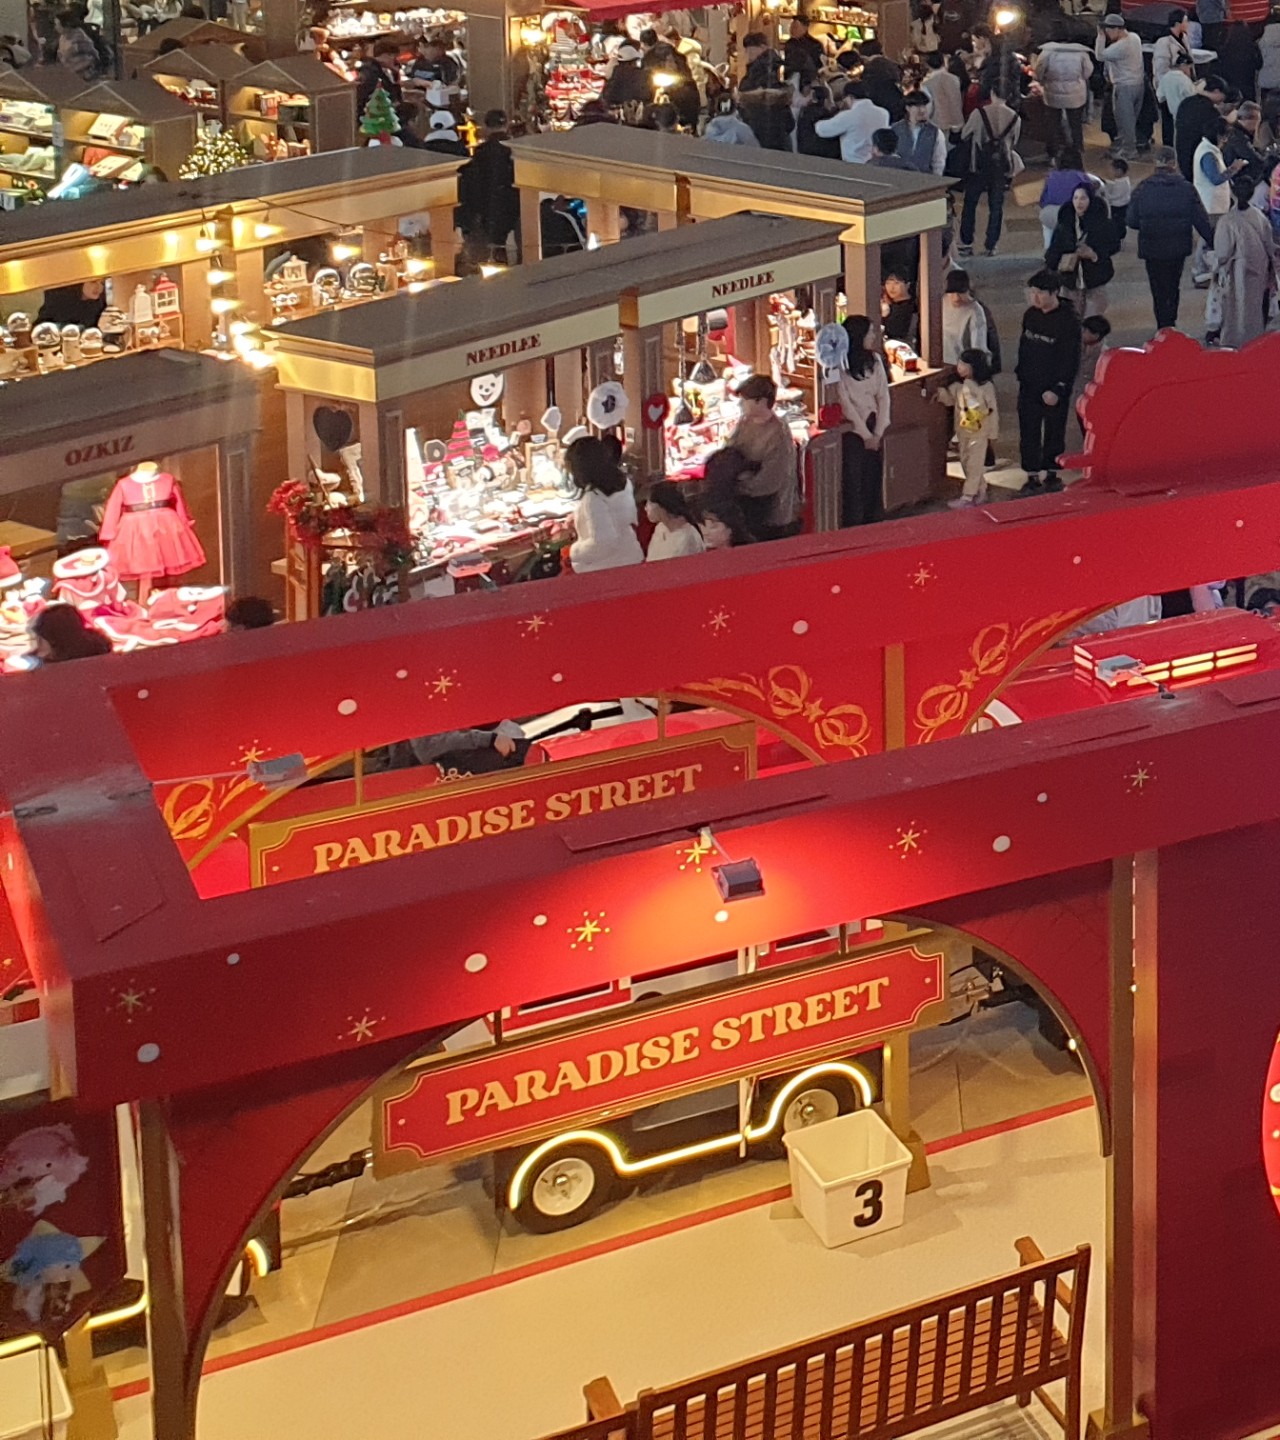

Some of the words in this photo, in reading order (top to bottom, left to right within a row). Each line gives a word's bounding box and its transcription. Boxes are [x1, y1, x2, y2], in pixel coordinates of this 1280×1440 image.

[711, 270, 775, 299] NEEDLEE
[466, 333, 541, 367] NEEDLEE
[64, 435, 135, 467] OZKIZ
[313, 799, 536, 874] PARADISE
[544, 763, 703, 822] STREET
[444, 1026, 701, 1127] PARADISE
[709, 976, 890, 1052] STREET
[853, 1179, 884, 1229] 3
